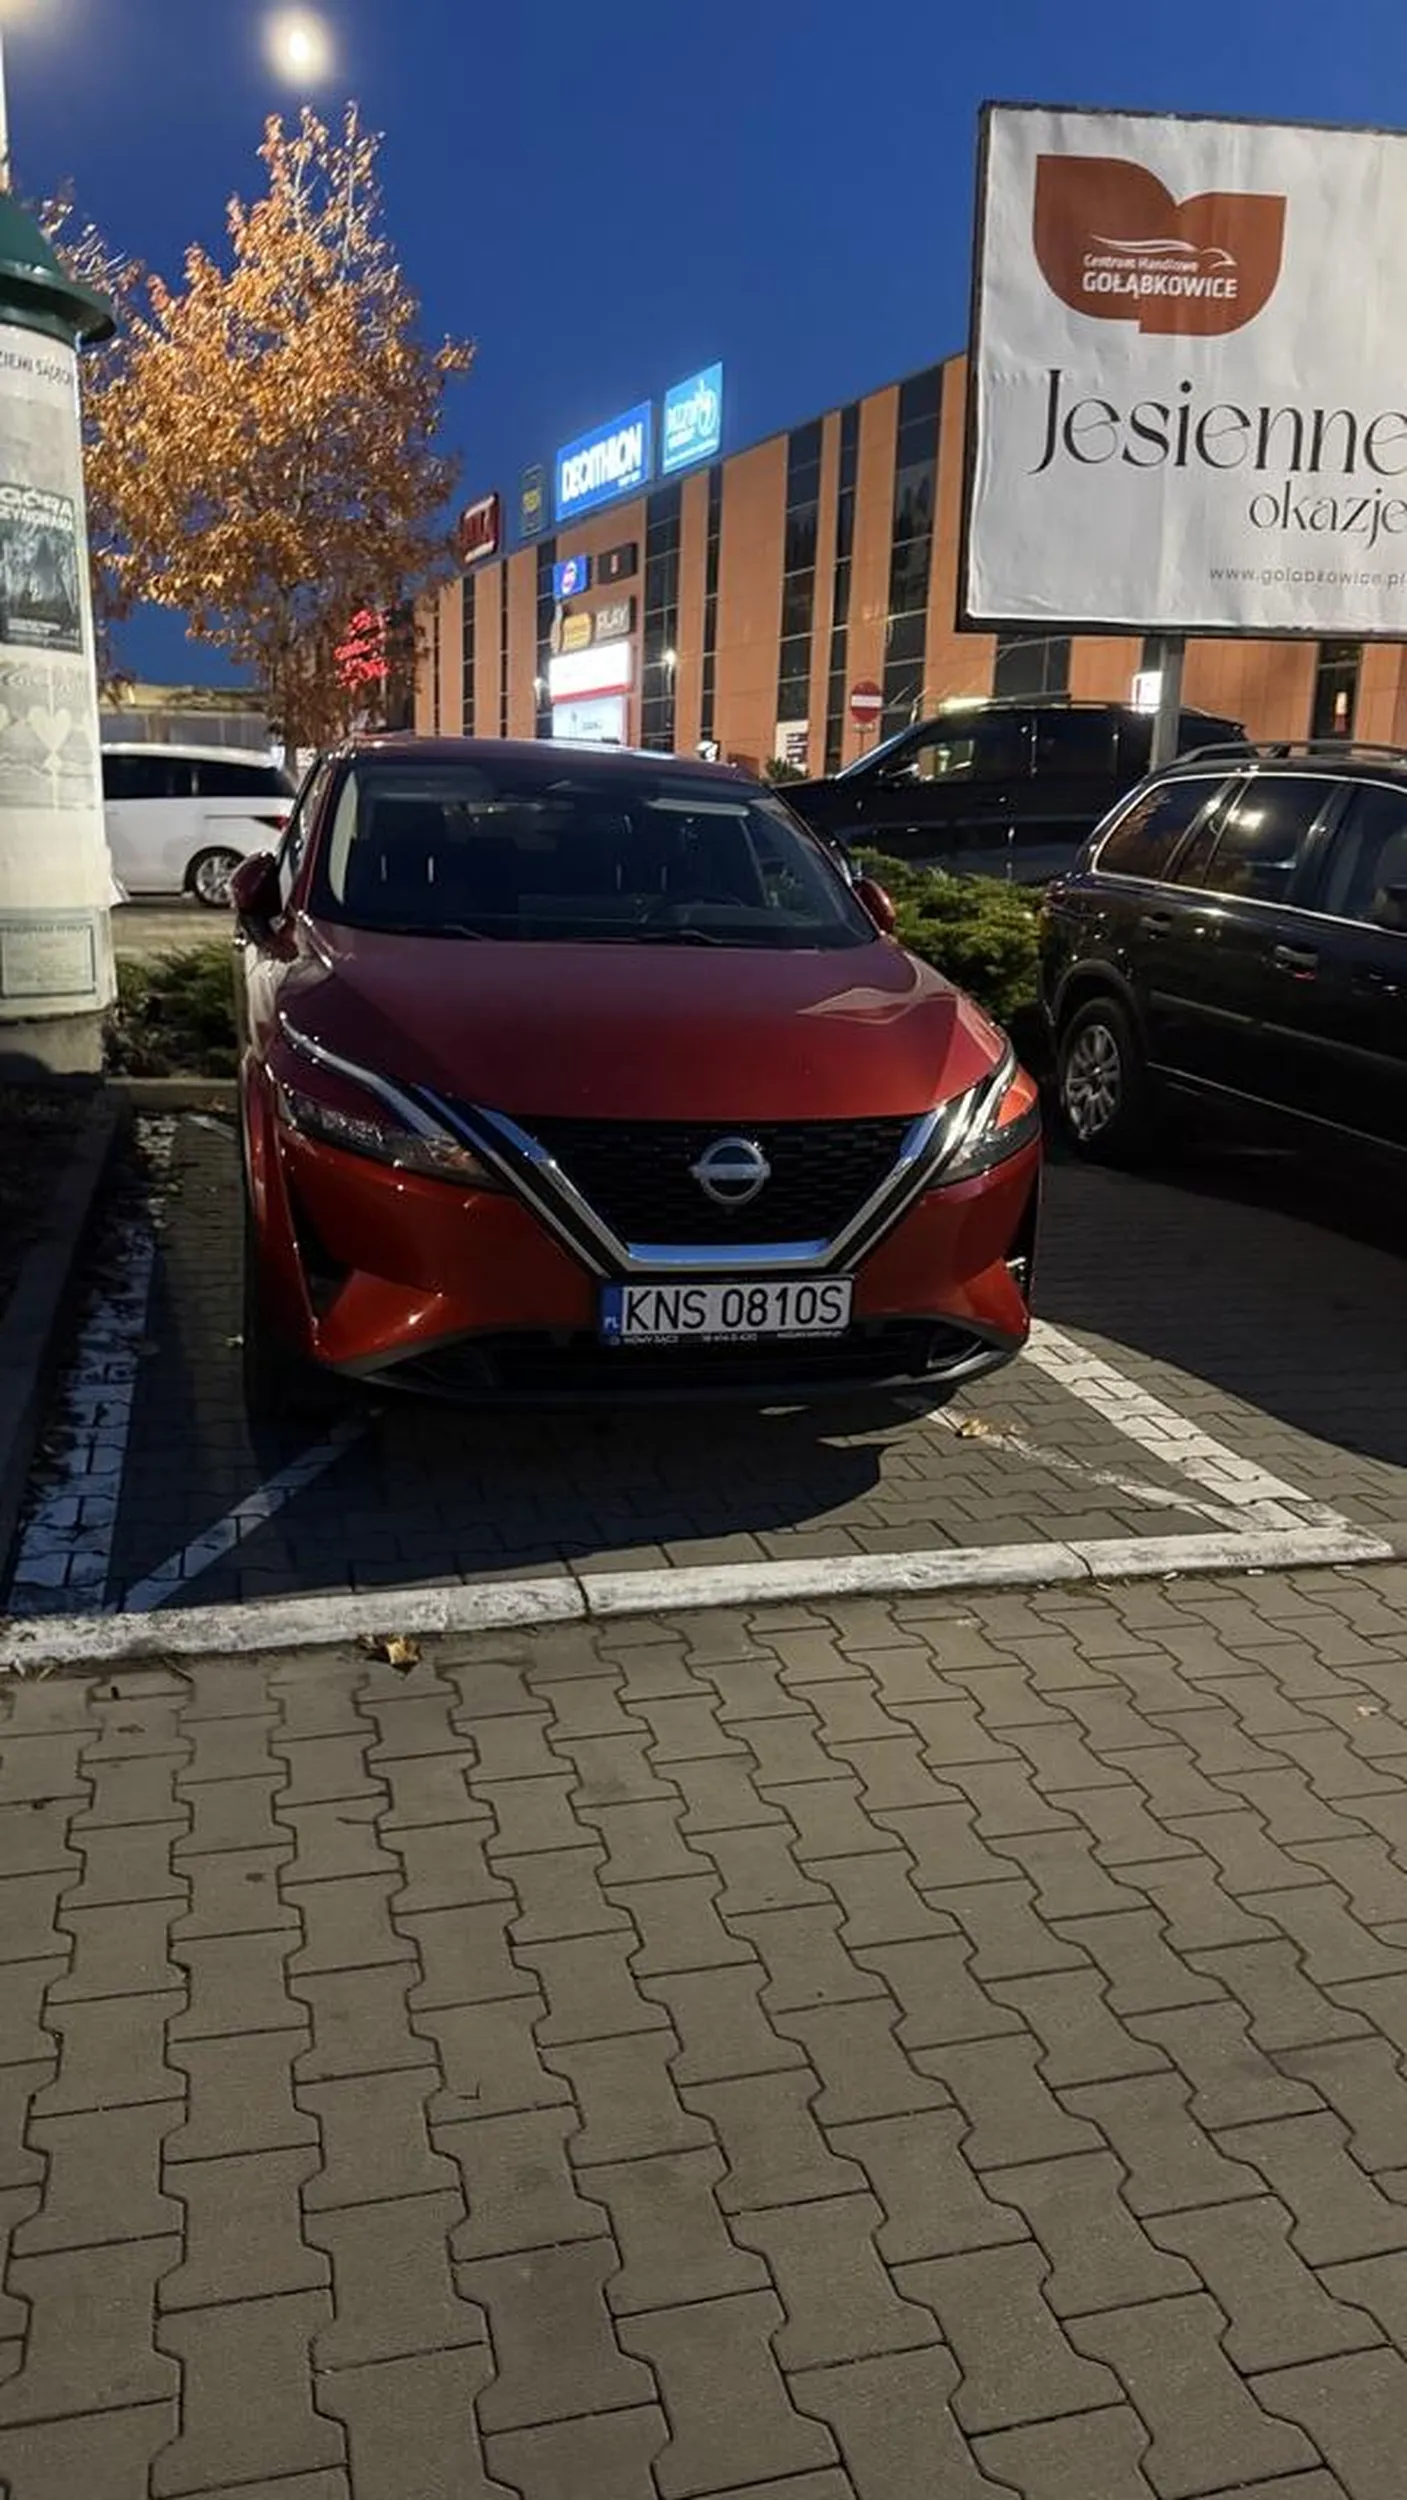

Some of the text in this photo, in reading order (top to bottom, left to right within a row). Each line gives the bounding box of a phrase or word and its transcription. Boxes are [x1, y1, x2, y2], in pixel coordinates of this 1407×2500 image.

[1083, 253, 1200, 272] Centrum Handlowe
[1082, 271, 1238, 299] GOŁĄBKOWICE
[1023, 369, 1407, 476] Jesienne
[1248, 481, 1407, 549] okazje
[604, 1316, 619, 1329] PL
[625, 1285, 843, 1332] KNS 0810S
